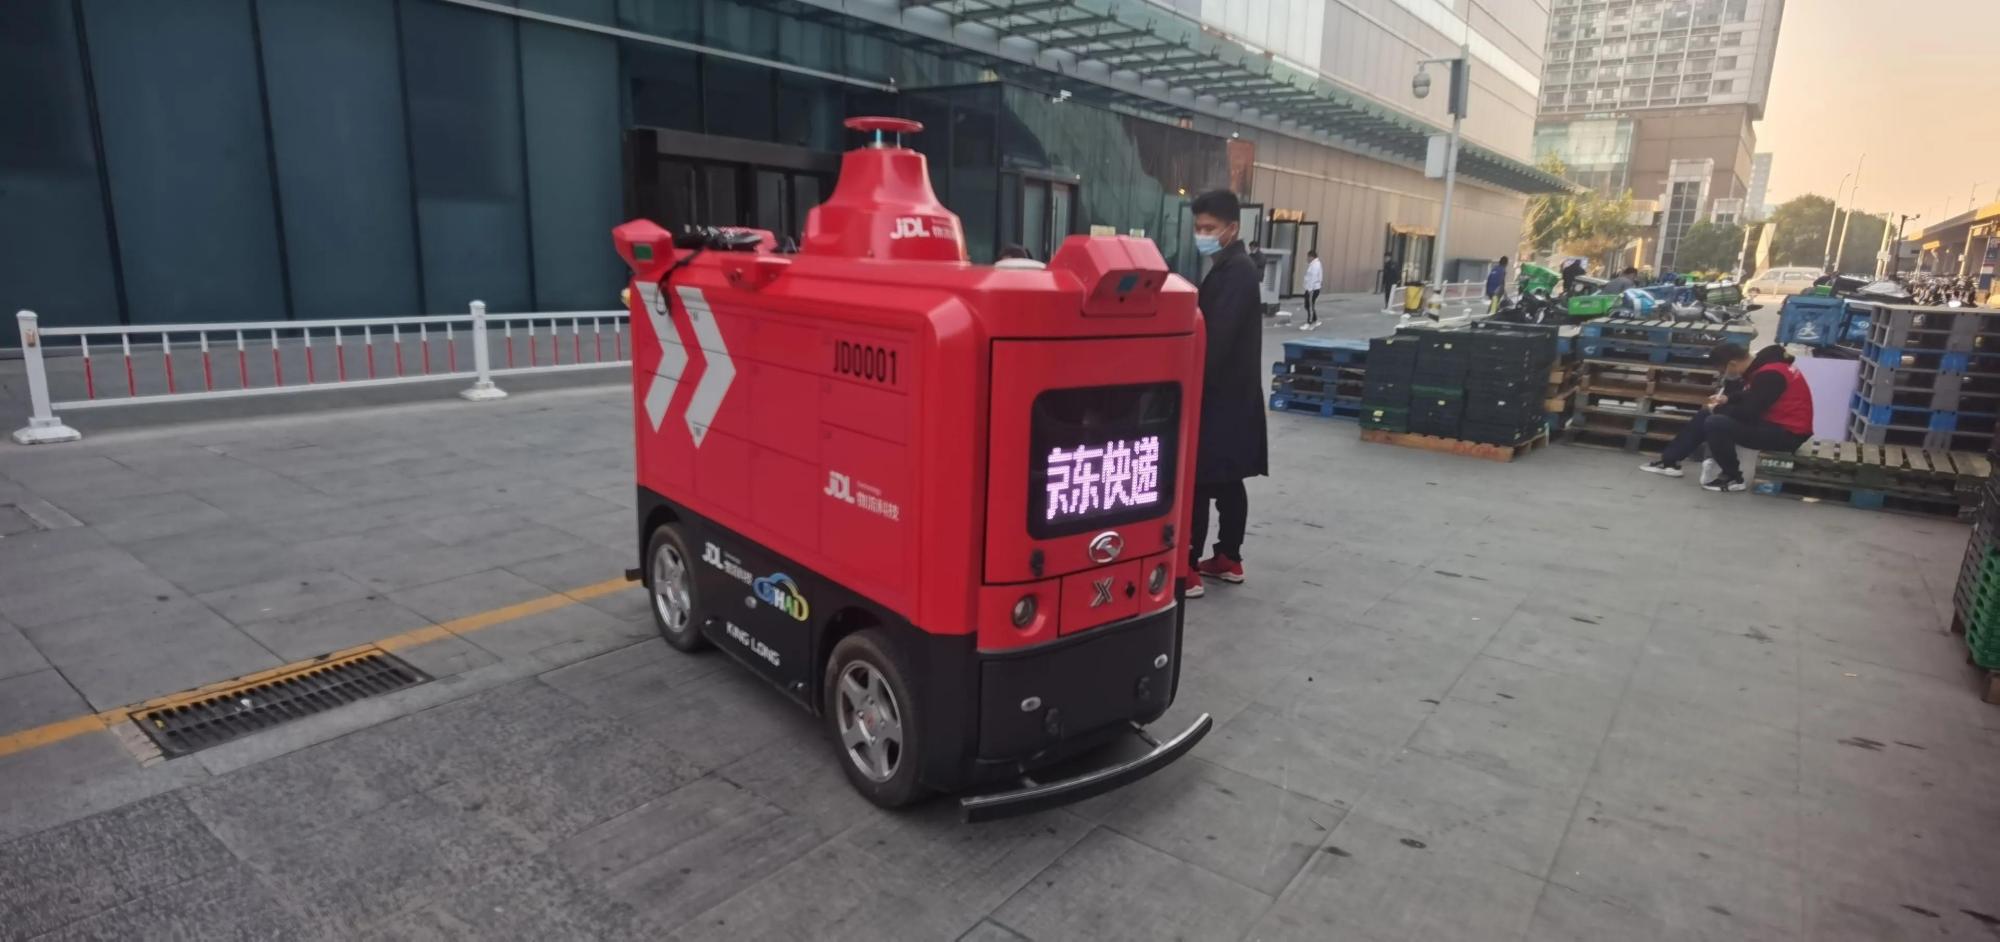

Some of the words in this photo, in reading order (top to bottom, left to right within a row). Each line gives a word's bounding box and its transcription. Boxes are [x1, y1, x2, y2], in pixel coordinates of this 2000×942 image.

[889, 216, 931, 240] JDL
[833, 339, 897, 386] JD0001
[823, 470, 855, 505] JDL
[1046, 436, 1159, 520] 京东快递
[702, 541, 724, 570] JDL
[726, 621, 750, 647] KING
[751, 637, 781, 667] LONG
